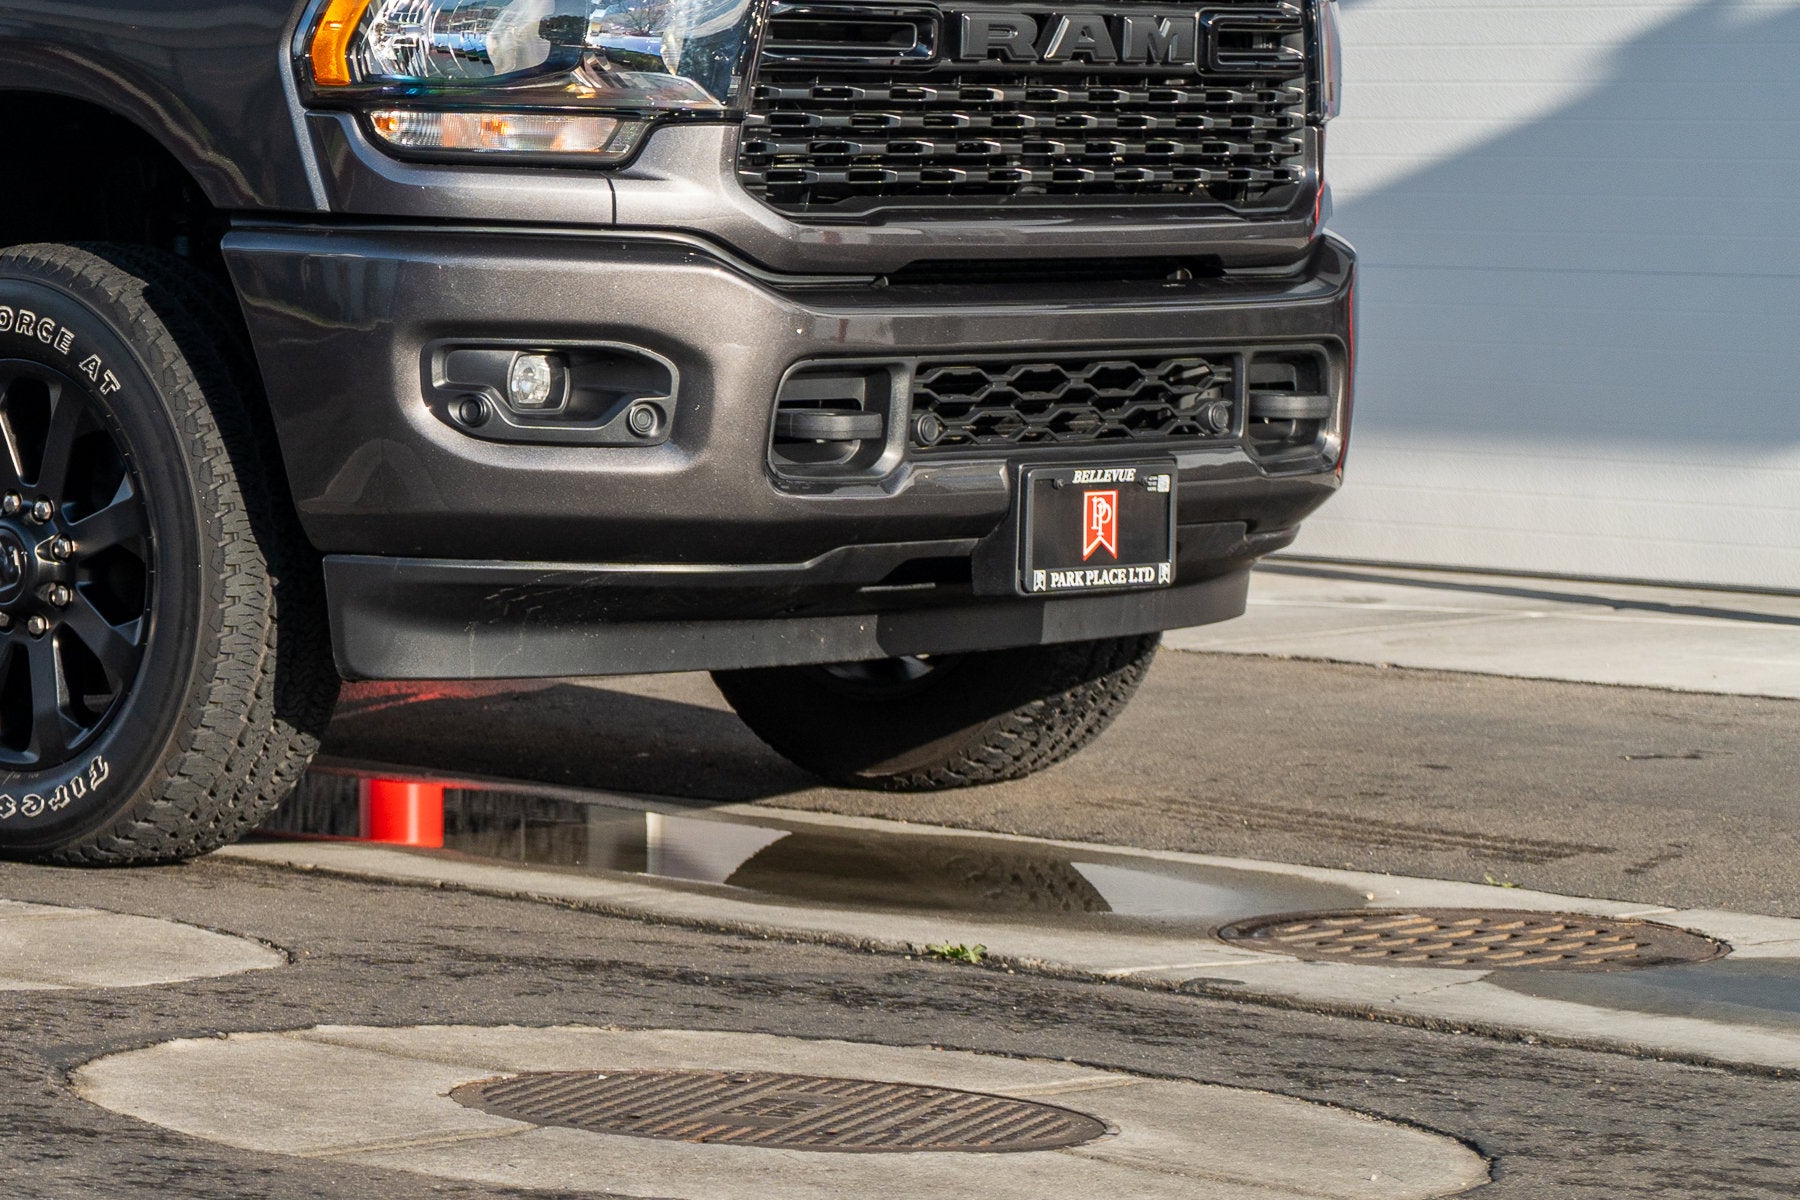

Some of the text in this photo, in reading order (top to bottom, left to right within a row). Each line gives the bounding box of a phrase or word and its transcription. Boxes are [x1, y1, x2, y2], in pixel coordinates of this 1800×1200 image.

[960, 12, 1196, 64] RAM
[78, 353, 122, 396] AT
[1072, 468, 1137, 485] BELLEVUE
[1050, 566, 1156, 588] PARK PLACE LTD
